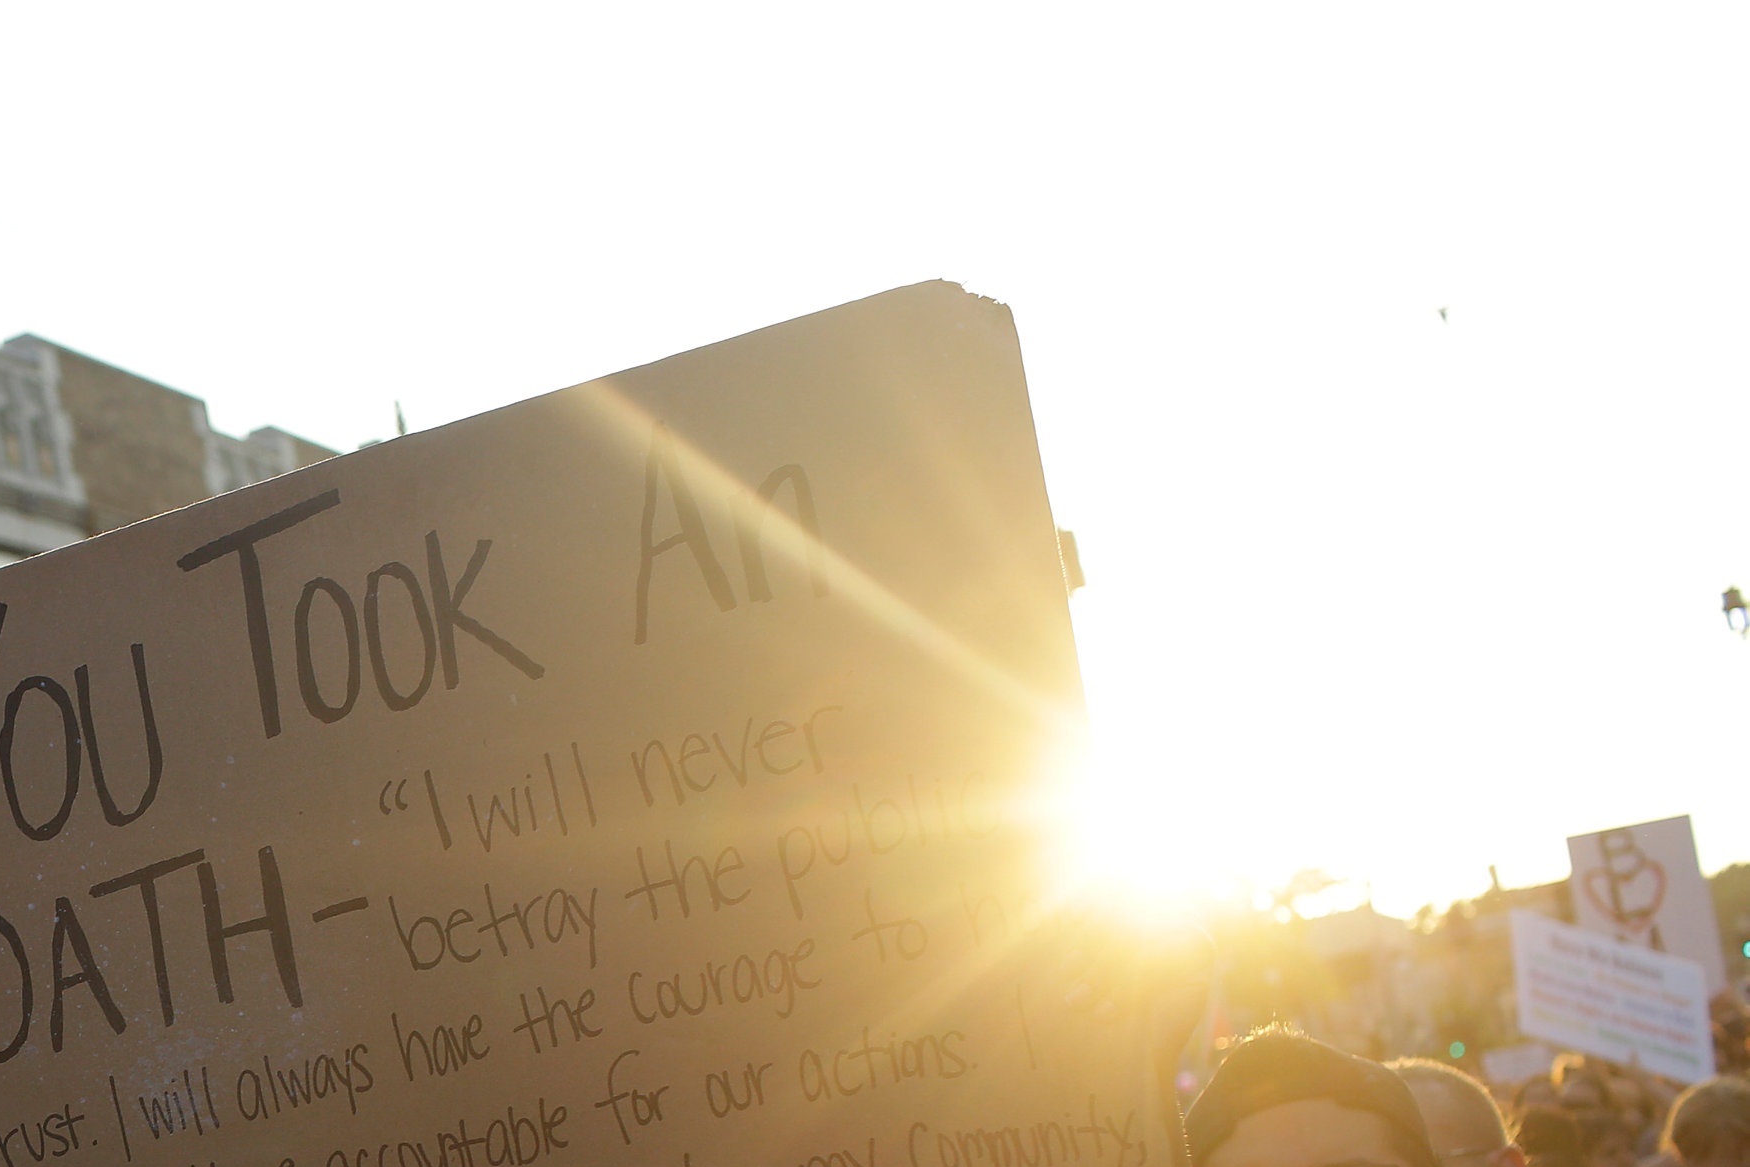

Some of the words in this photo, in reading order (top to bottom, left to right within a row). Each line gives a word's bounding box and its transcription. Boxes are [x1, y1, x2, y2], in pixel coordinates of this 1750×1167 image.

[467, 741, 597, 853] will
[631, 704, 843, 807] never
[388, 883, 598, 970] betray
[625, 840, 751, 920] the
[777, 770, 999, 920] public
[139, 1066, 221, 1140] will
[236, 1042, 373, 1115] always
[391, 1012, 491, 1082] have
[514, 986, 603, 1054] the
[628, 937, 822, 1025] courage
[852, 888, 928, 963] to
[596, 1049, 670, 1145] for
[705, 1059, 773, 1119] our
[799, 1025, 979, 1104] actions.
